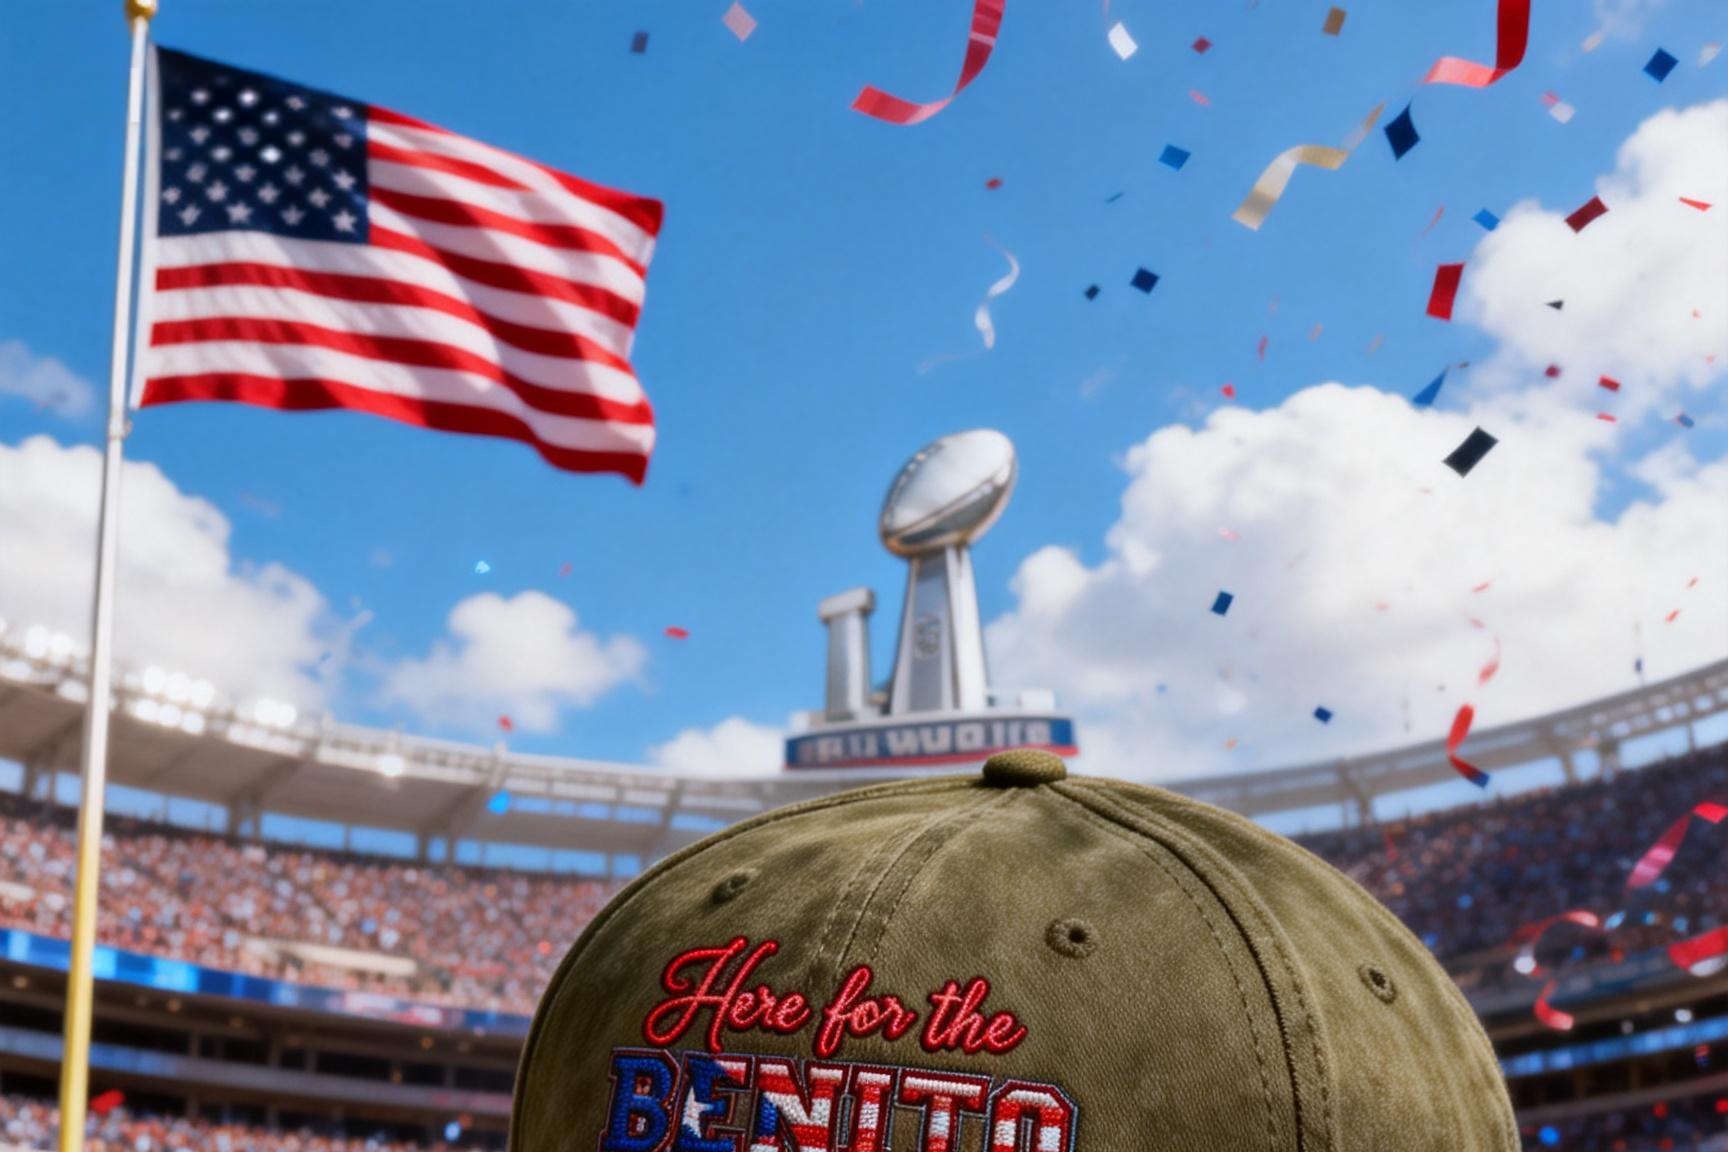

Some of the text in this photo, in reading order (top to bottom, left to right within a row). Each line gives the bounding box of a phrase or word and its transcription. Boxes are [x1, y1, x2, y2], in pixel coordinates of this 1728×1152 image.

[643, 936, 1028, 1057] Here for the
